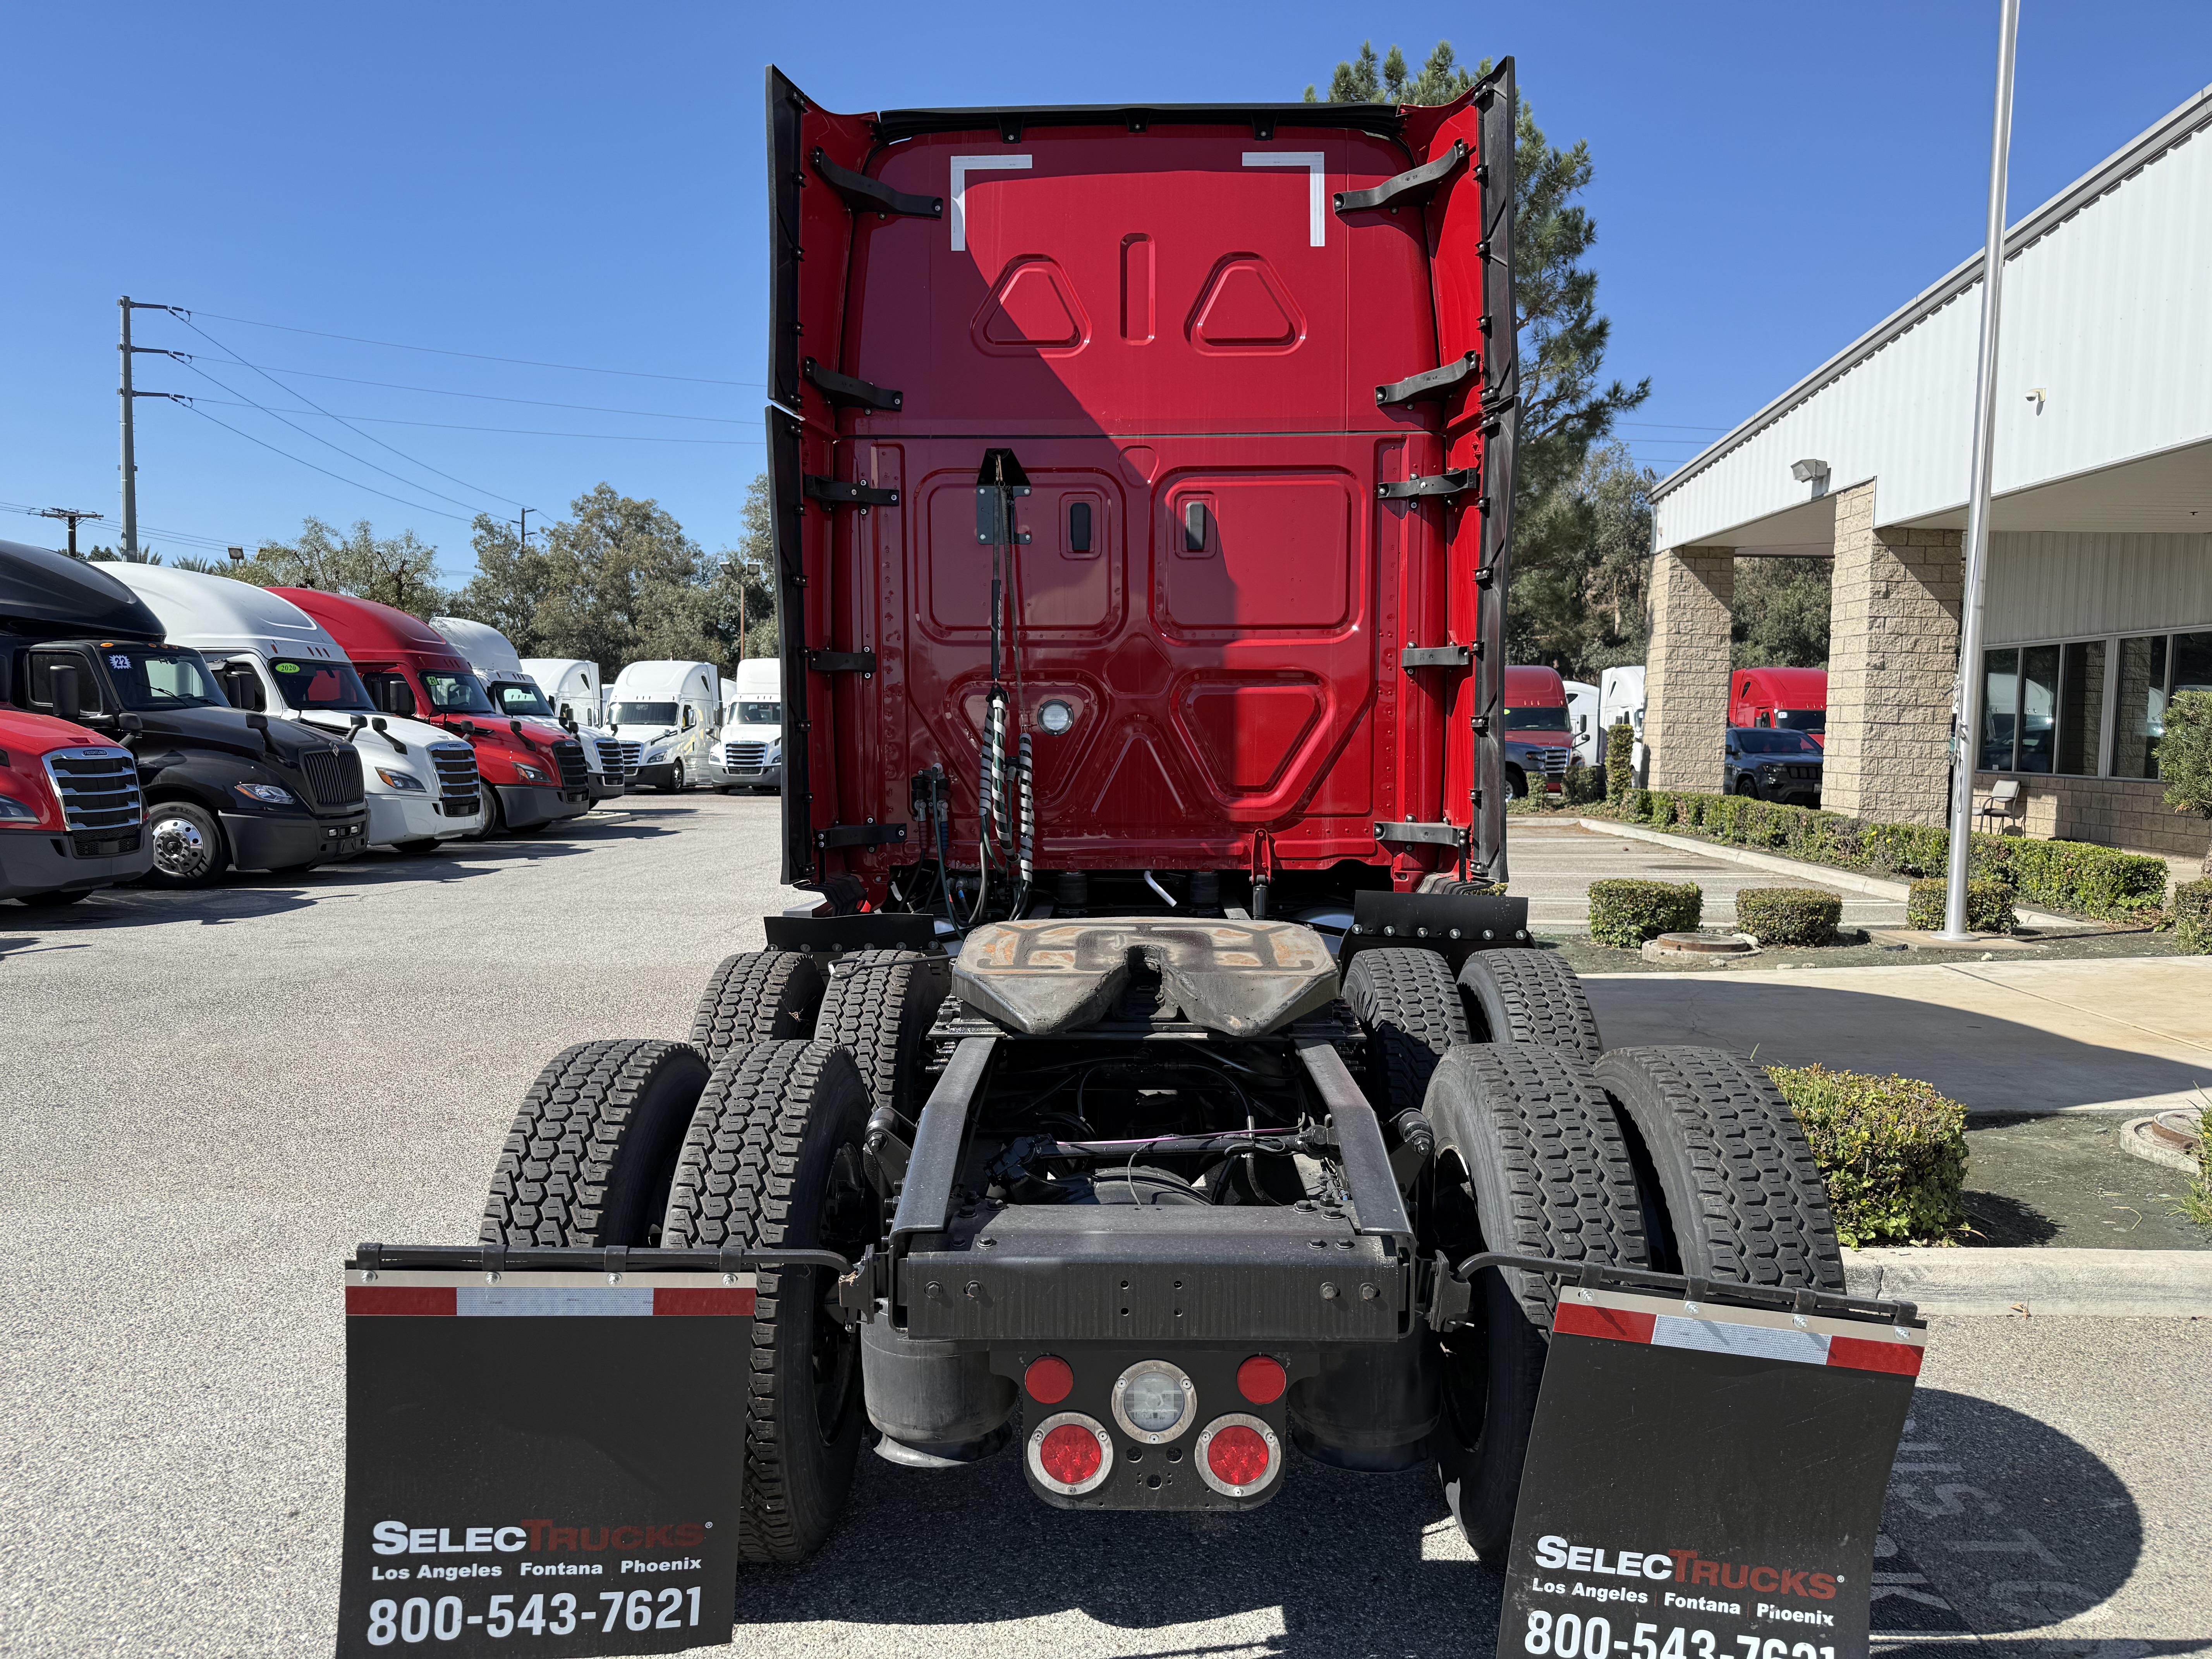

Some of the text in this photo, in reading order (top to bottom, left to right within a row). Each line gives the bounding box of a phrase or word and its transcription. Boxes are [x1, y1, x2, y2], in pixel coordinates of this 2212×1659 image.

[115, 657, 127, 666] 22
[372, 1557, 702, 1581] Los Angeles Fontana Phoenix
[367, 1586, 701, 1646] 800-543-7621
[1532, 1578, 1834, 1626] Los Angeles Fontana Phoenix
